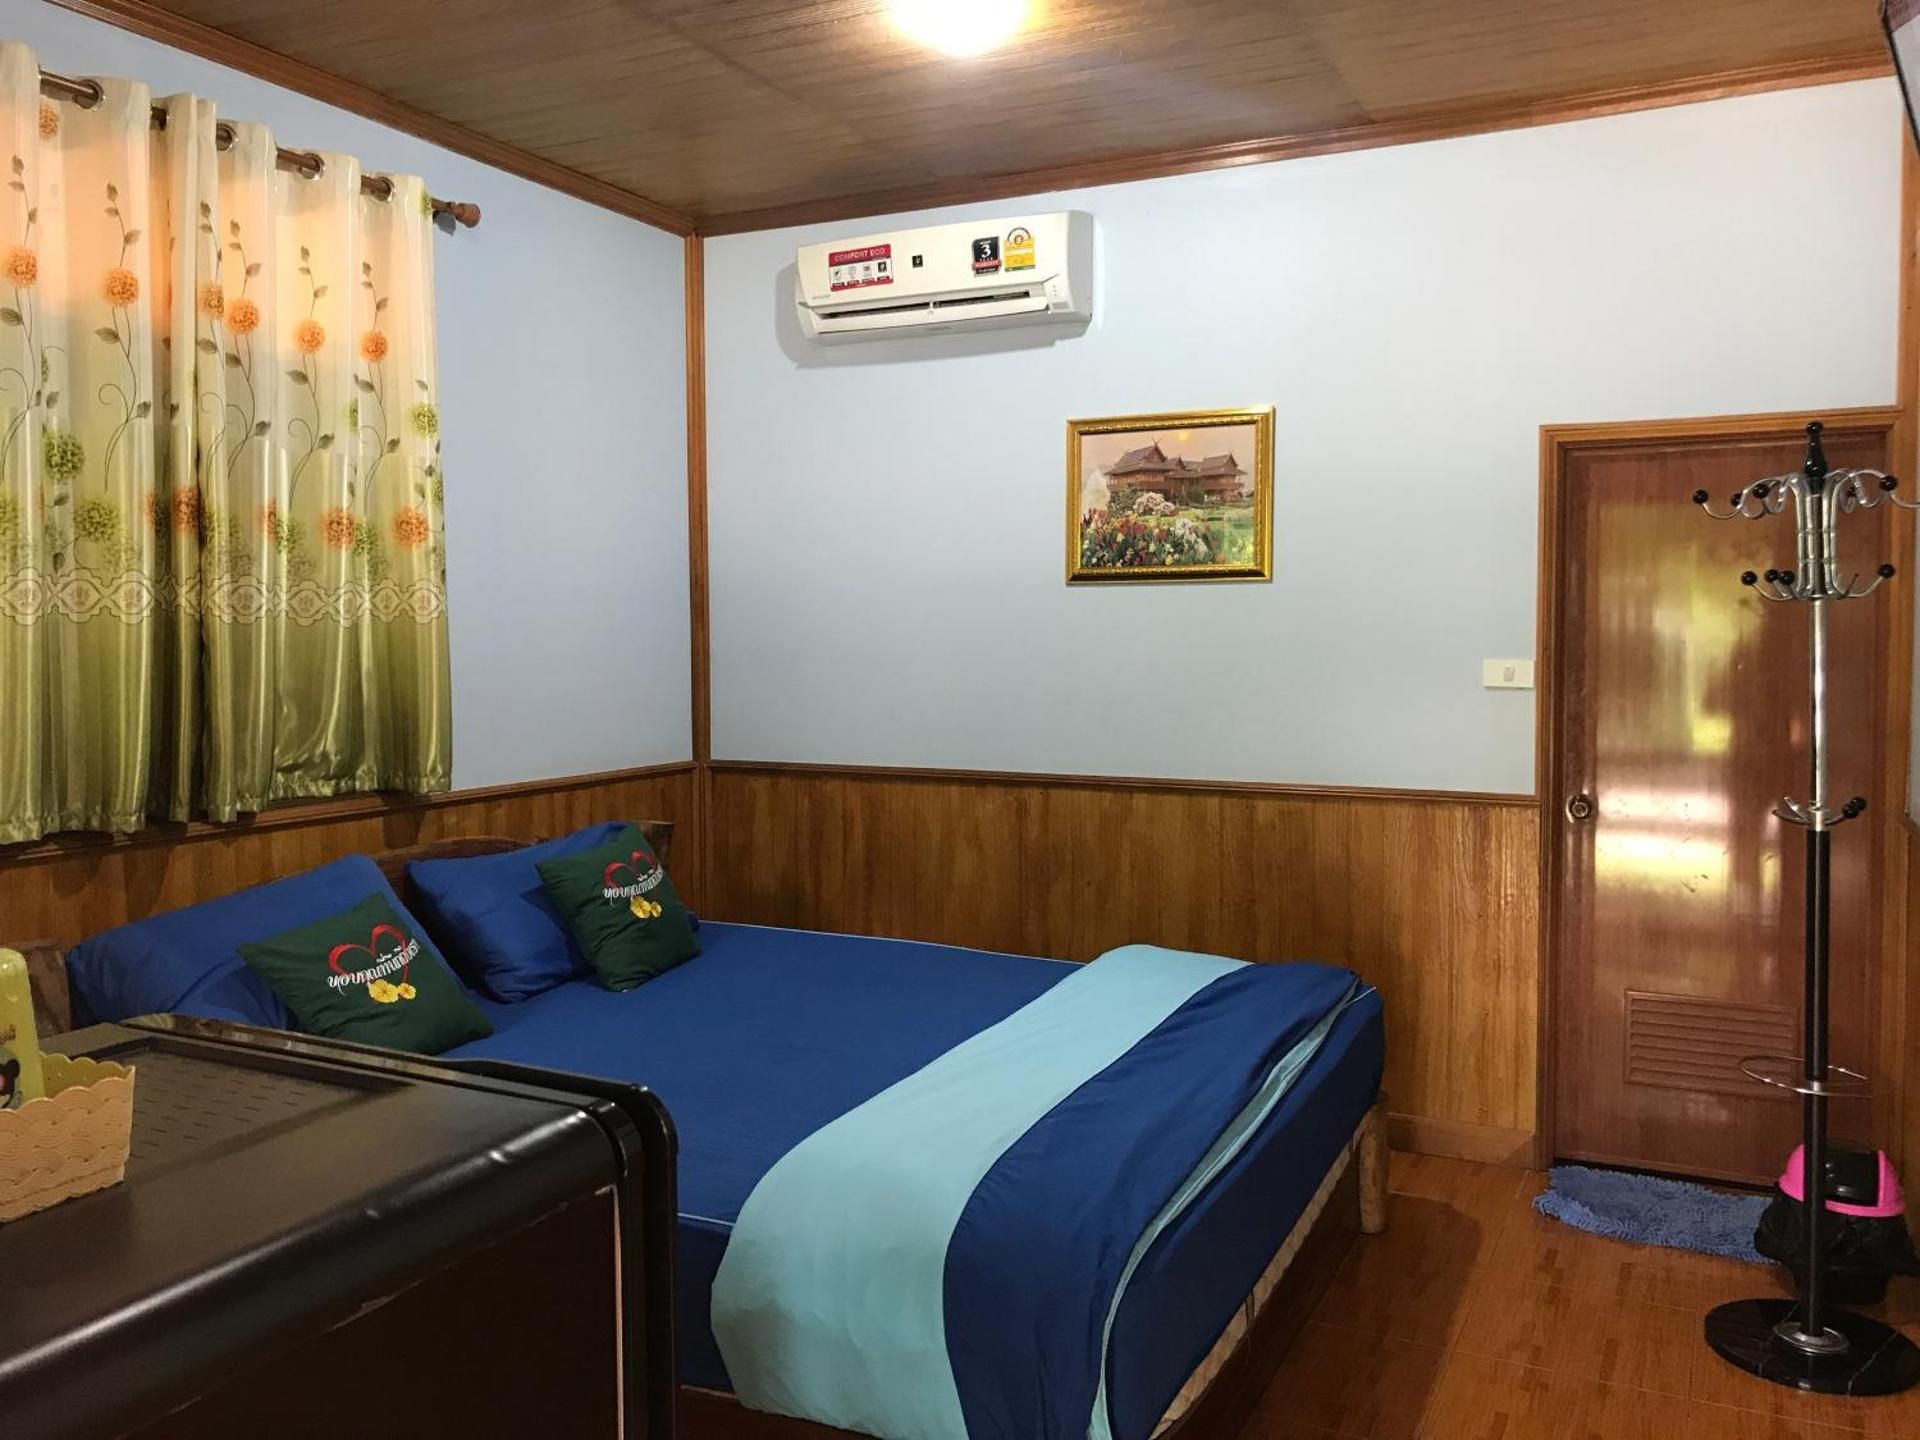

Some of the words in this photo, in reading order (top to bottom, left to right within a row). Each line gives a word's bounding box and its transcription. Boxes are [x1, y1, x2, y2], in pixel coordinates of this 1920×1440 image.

[834, 249, 869, 262] COMFORT
[870, 247, 886, 257] ECO
[981, 244, 991, 258] 3
